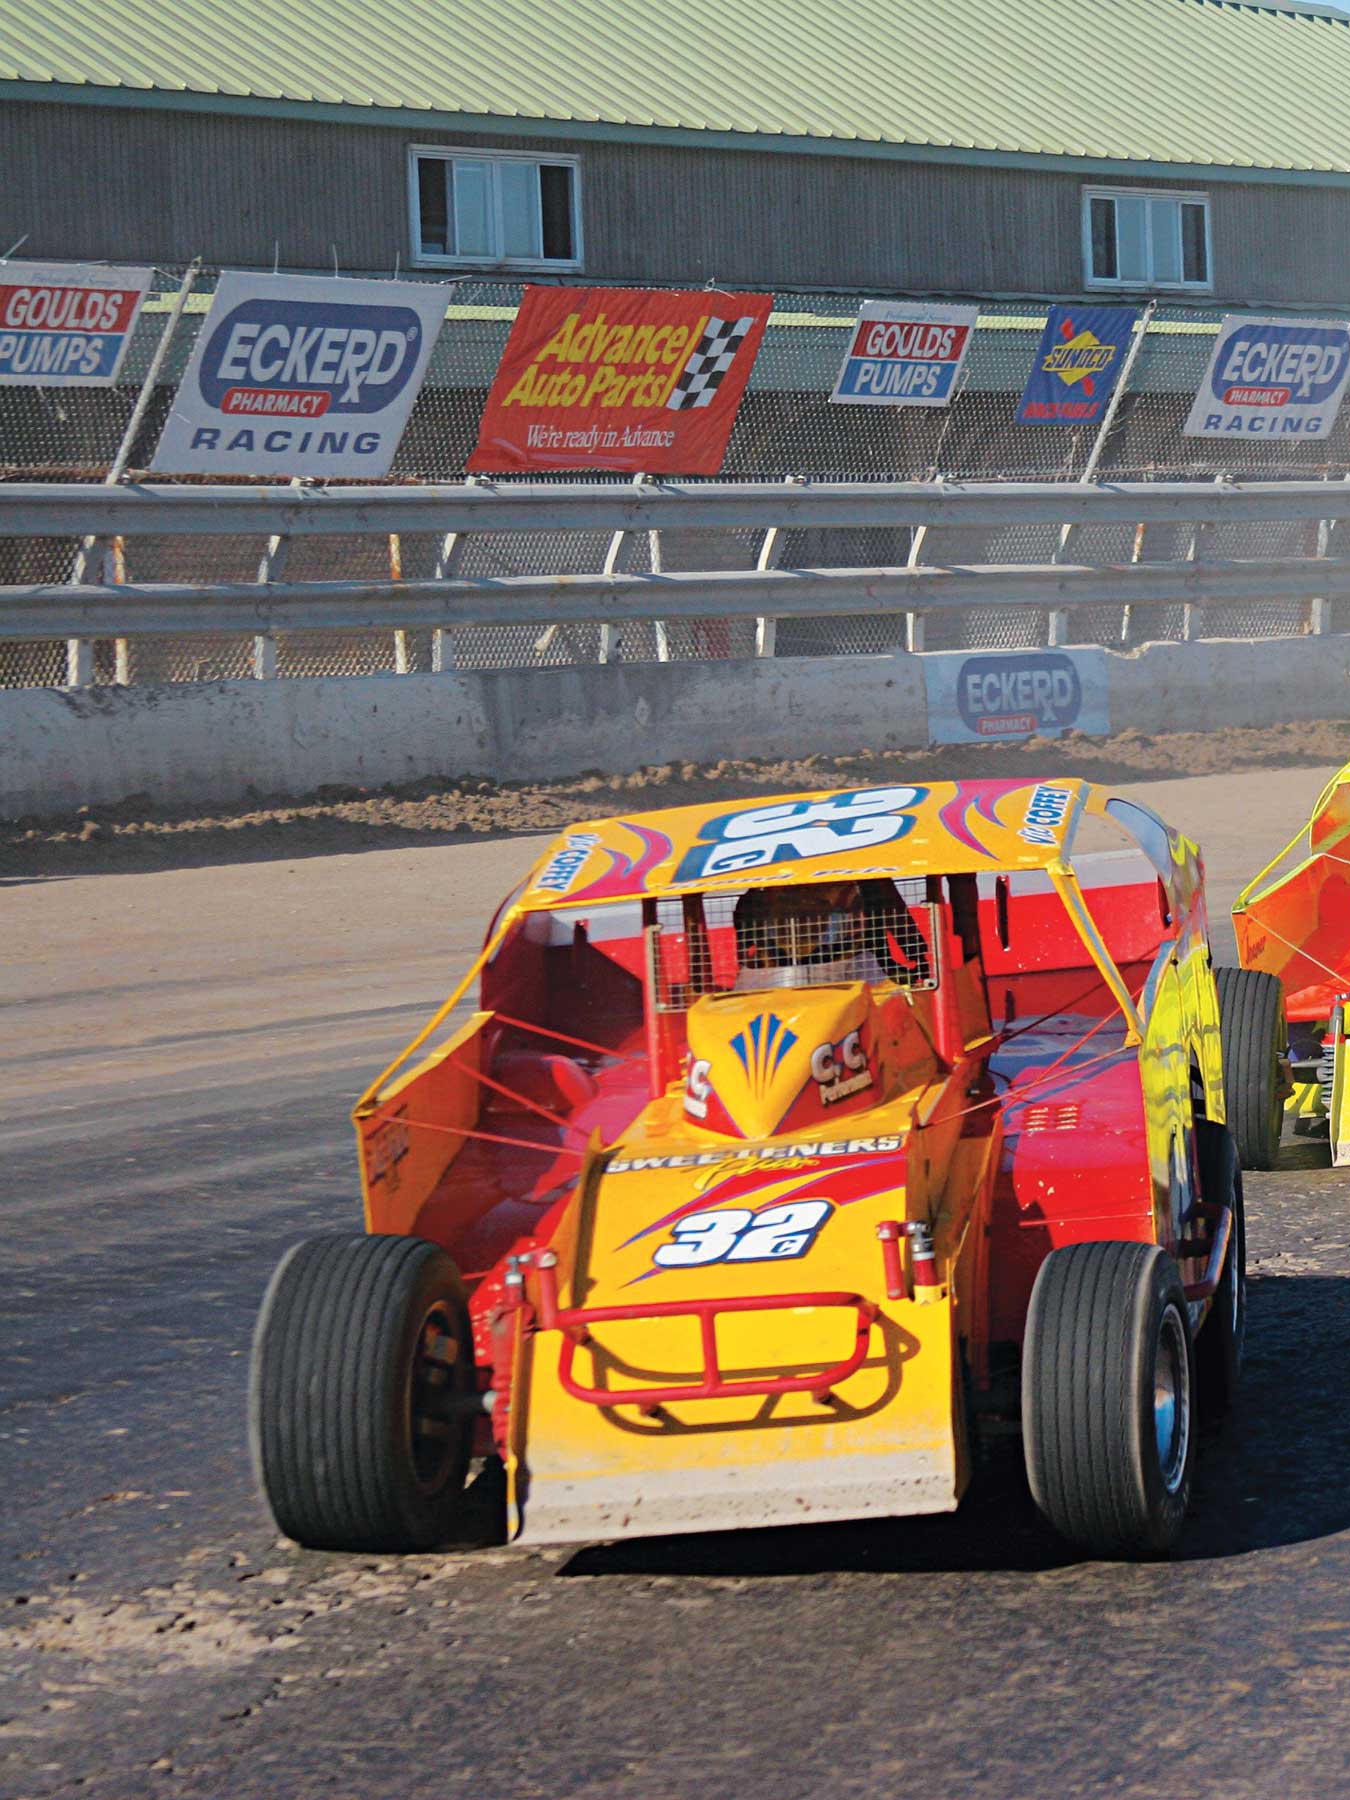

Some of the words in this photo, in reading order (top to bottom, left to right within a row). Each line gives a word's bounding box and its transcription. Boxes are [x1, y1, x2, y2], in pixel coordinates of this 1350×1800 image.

[5, 288, 123, 330] GOULDS
[0, 335, 104, 374] PUMPS
[535, 313, 689, 365] Advance
[867, 323, 956, 358] GOULDS
[217, 322, 407, 404] ECKERD
[854, 363, 941, 396] PUMPS
[1222, 341, 1342, 398] ECKERD
[228, 391, 323, 415] PHARMACY
[501, 364, 586, 408] Auto
[582, 366, 665, 408] Parts
[1228, 390, 1285, 404] PHARMACY
[189, 427, 381, 454] RACING
[527, 424, 562, 448] We're
[563, 424, 601, 454] ready
[601, 424, 617, 448] in
[616, 424, 676, 448] Advance
[1203, 414, 1323, 433] RACING
[966, 669, 1074, 721] ECKERD
[1026, 785, 1072, 826] COFFEY
